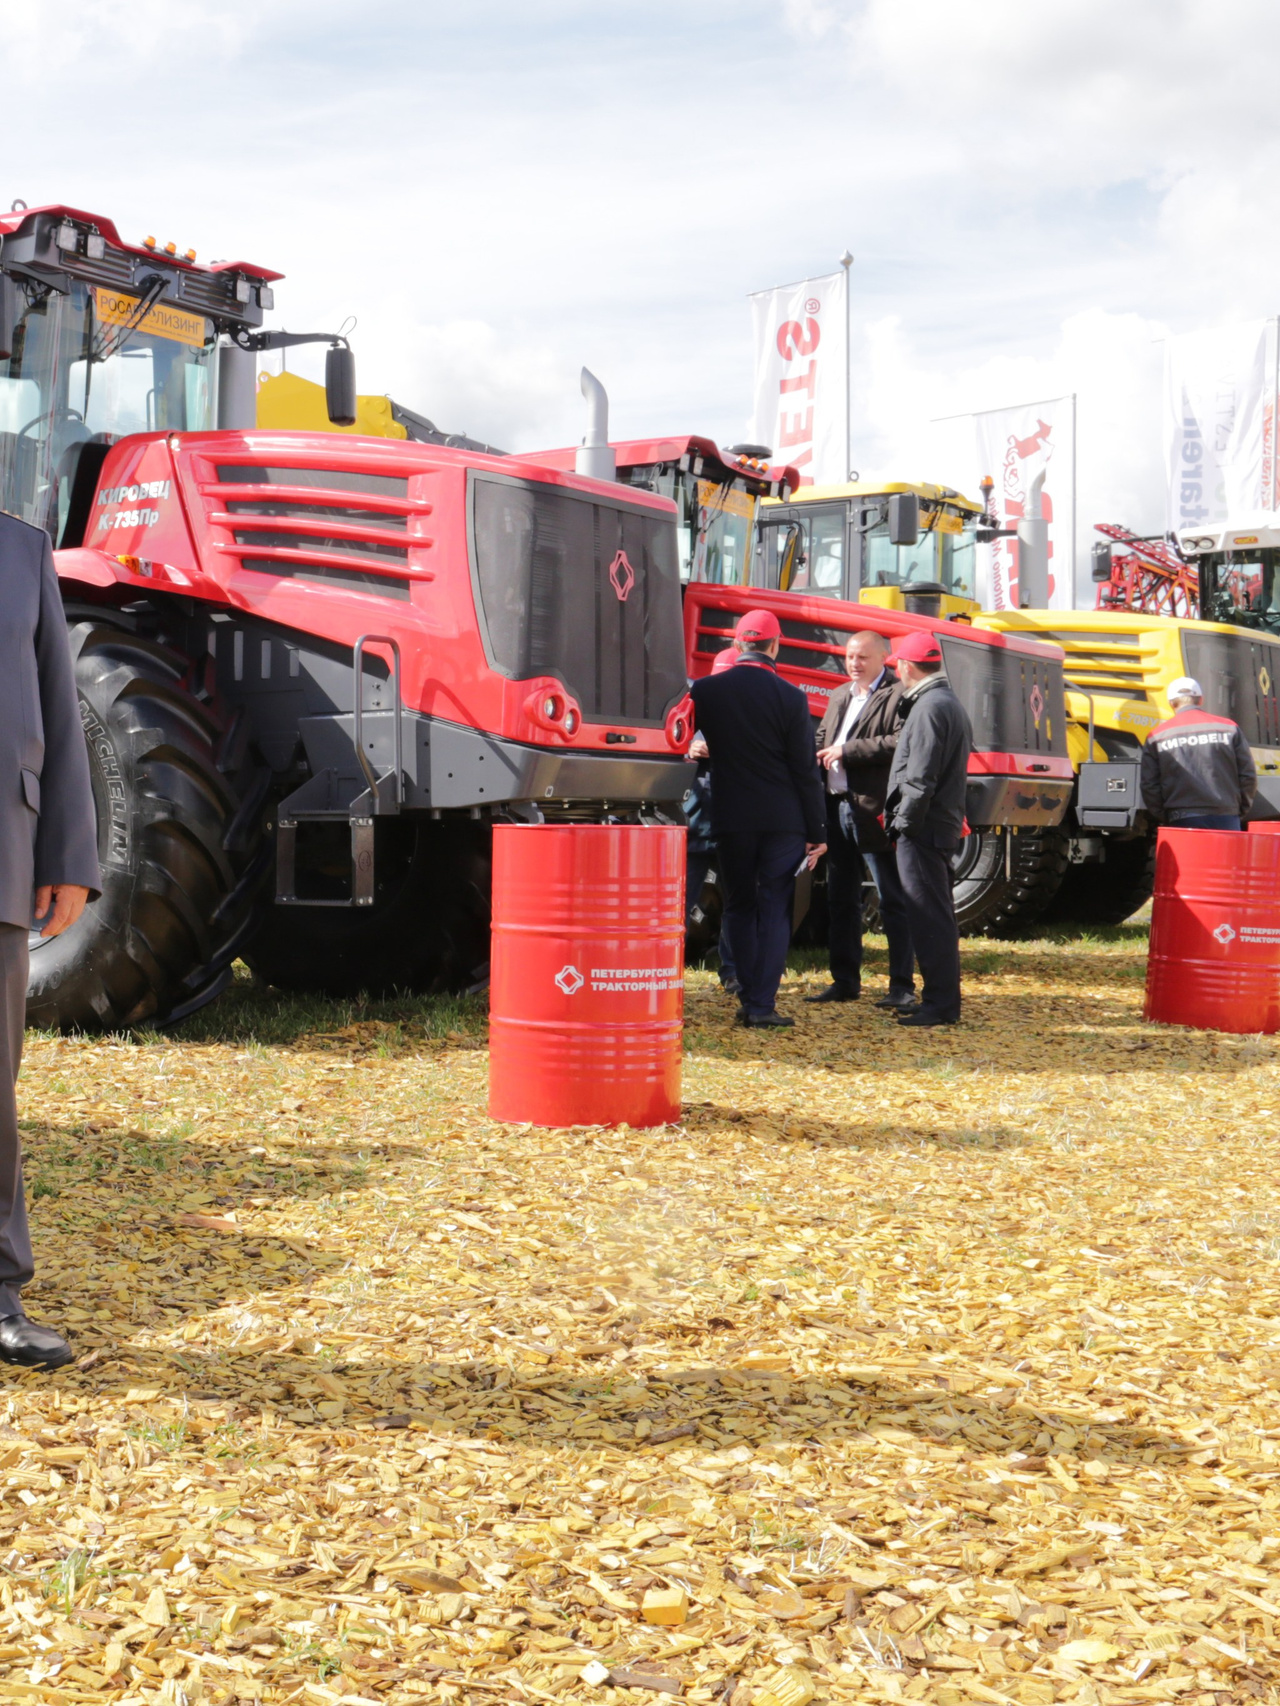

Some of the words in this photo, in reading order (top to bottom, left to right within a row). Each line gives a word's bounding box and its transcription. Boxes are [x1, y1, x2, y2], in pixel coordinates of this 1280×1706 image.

[97, 480, 171, 506] КИРОВЕЦ
[98, 508, 160, 531] К-735Пр
[1157, 732, 1230, 752] КИРОВЕЦ
[78, 700, 130, 865] MICHELIN
[591, 966, 678, 978] ПЕТЕРБУРГСКИЙ
[591, 979, 668, 991] ТРАКТОРНЫЙ
